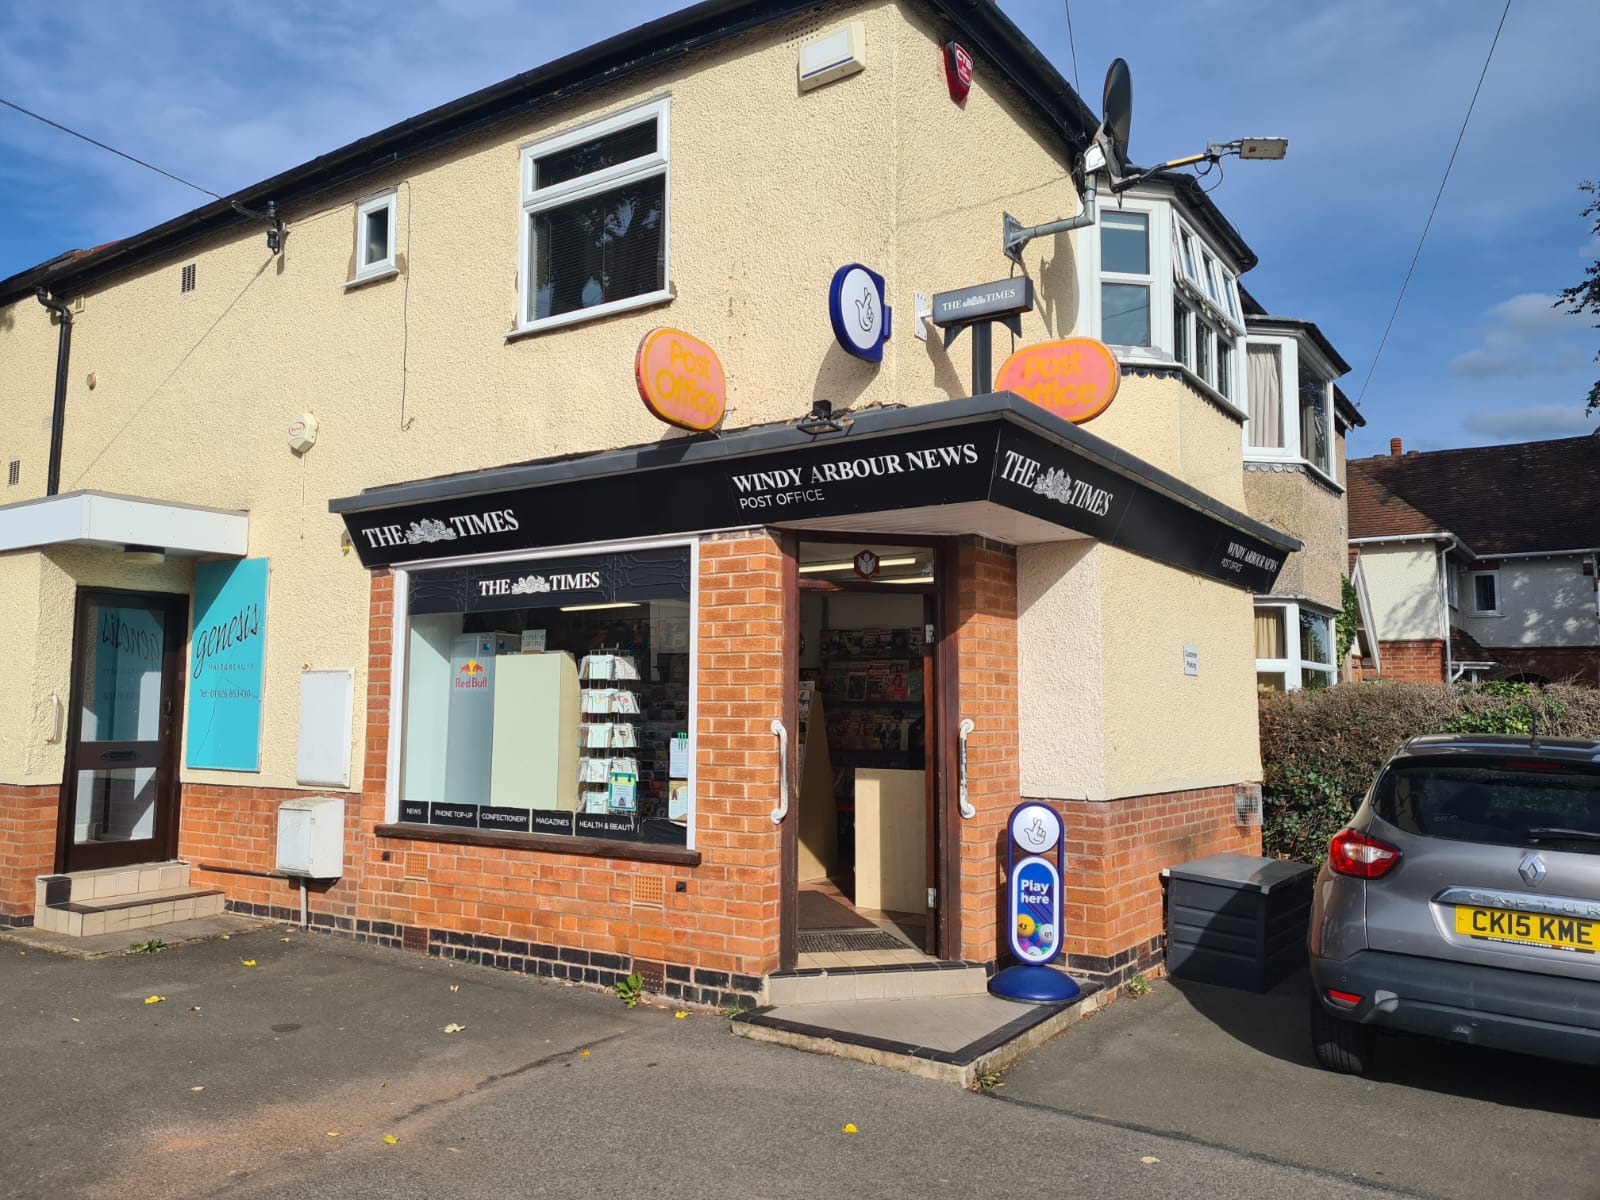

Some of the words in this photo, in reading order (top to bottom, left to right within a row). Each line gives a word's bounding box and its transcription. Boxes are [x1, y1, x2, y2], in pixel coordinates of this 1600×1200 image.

[942, 299, 962, 311] THE
[985, 288, 1016, 303] TIMES
[671, 339, 711, 383] Post
[1024, 351, 1083, 381] Post
[655, 369, 719, 416] Office
[732, 467, 802, 493] WINDY
[810, 454, 904, 484] ARBOUR
[906, 443, 979, 472] NEWS
[1001, 450, 1041, 488] THE
[1069, 480, 1114, 517] TIMES
[739, 495, 772, 510] POST
[776, 488, 825, 505] OFFICE
[362, 524, 408, 548] THE
[450, 509, 519, 537] TIMES
[1227, 541, 1248, 560] WINDY
[479, 579, 511, 596] THE
[549, 571, 600, 591] TIMES
[193, 602, 259, 679] genesis
[455, 677, 471, 688] Red
[472, 676, 487, 688] Bull
[406, 807, 422, 815] NEWS
[434, 809, 453, 817] PHONE
[454, 811, 473, 819] TOP-UP
[481, 813, 528, 823] CONFECTIONERY
[536, 817, 570, 827] MAGAZINES
[579, 820, 603, 829] HEALTH
[609, 822, 636, 832] BEAUTY
[1020, 879, 1050, 895] Play
[1020, 892, 1050, 904] here
[1472, 910, 1531, 937] CK15
[1539, 917, 1593, 945] KME
